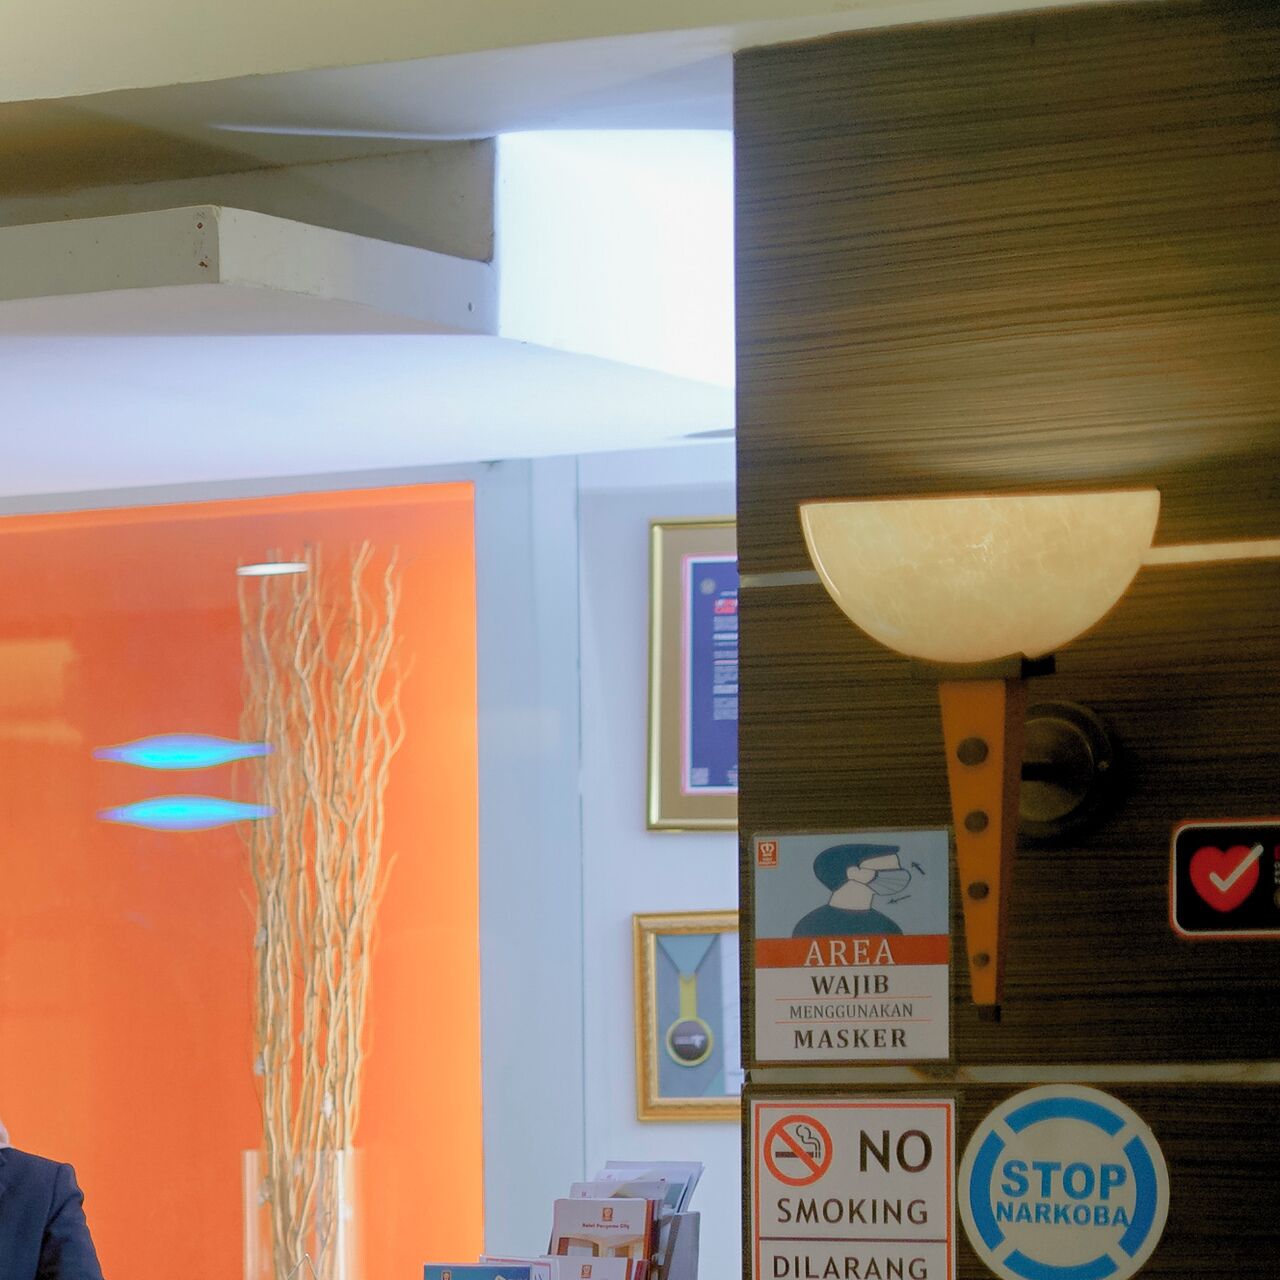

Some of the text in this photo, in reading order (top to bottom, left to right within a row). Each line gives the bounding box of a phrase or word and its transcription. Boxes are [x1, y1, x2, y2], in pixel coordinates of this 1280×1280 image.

[803, 938, 896, 967] AREA
[810, 974, 889, 999] WAJIB
[789, 1003, 913, 1019] MENGGUNAKAN
[793, 1028, 908, 1049] MASKER
[859, 1129, 933, 1174] NO
[1001, 1159, 1128, 1200] STOP
[777, 1198, 928, 1225] SMOKING
[995, 1201, 1131, 1228] NARKOBA
[773, 1255, 928, 1280] DILARANG
